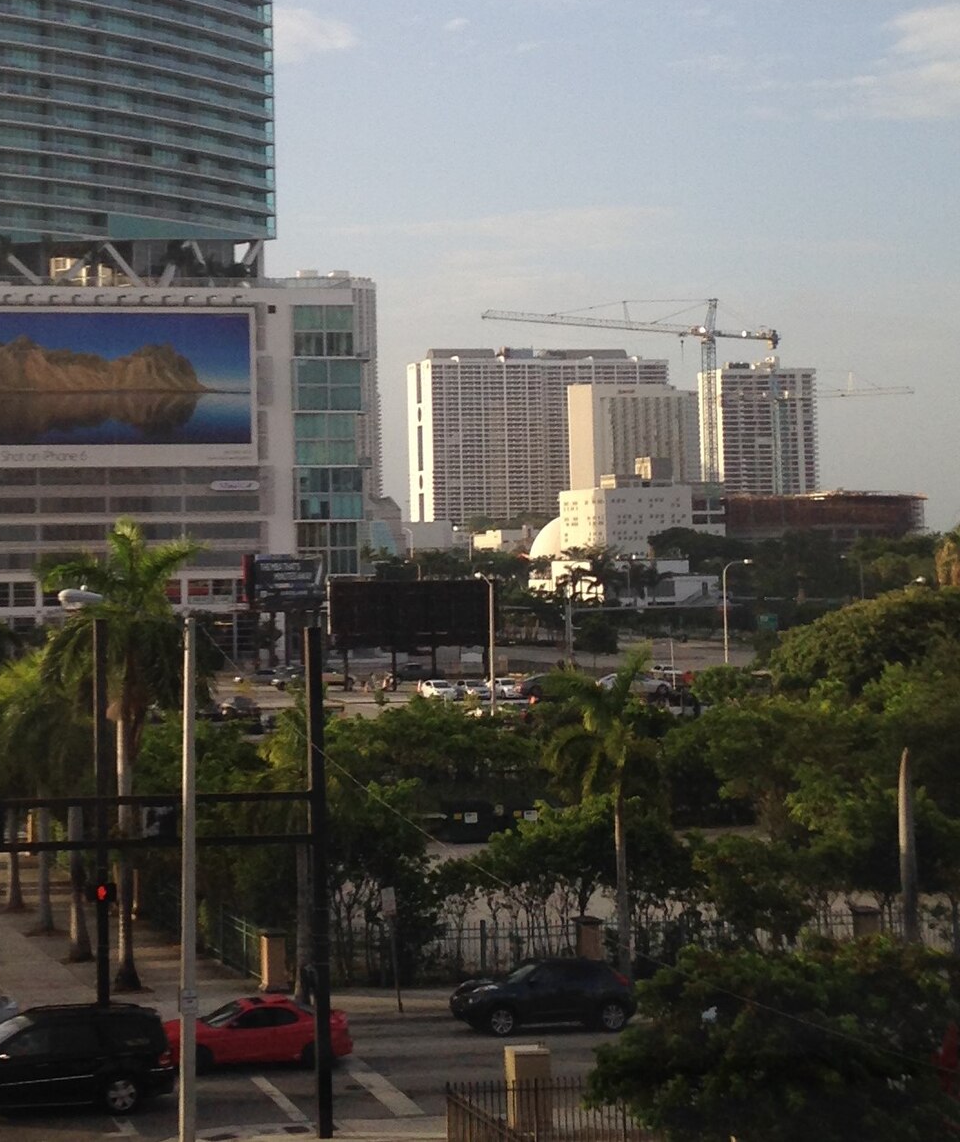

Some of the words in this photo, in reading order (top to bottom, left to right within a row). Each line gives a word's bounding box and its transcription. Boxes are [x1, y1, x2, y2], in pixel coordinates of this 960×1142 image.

[0, 450, 24, 462] Shot
[26, 452, 39, 462] on
[42, 450, 77, 462] iPhone
